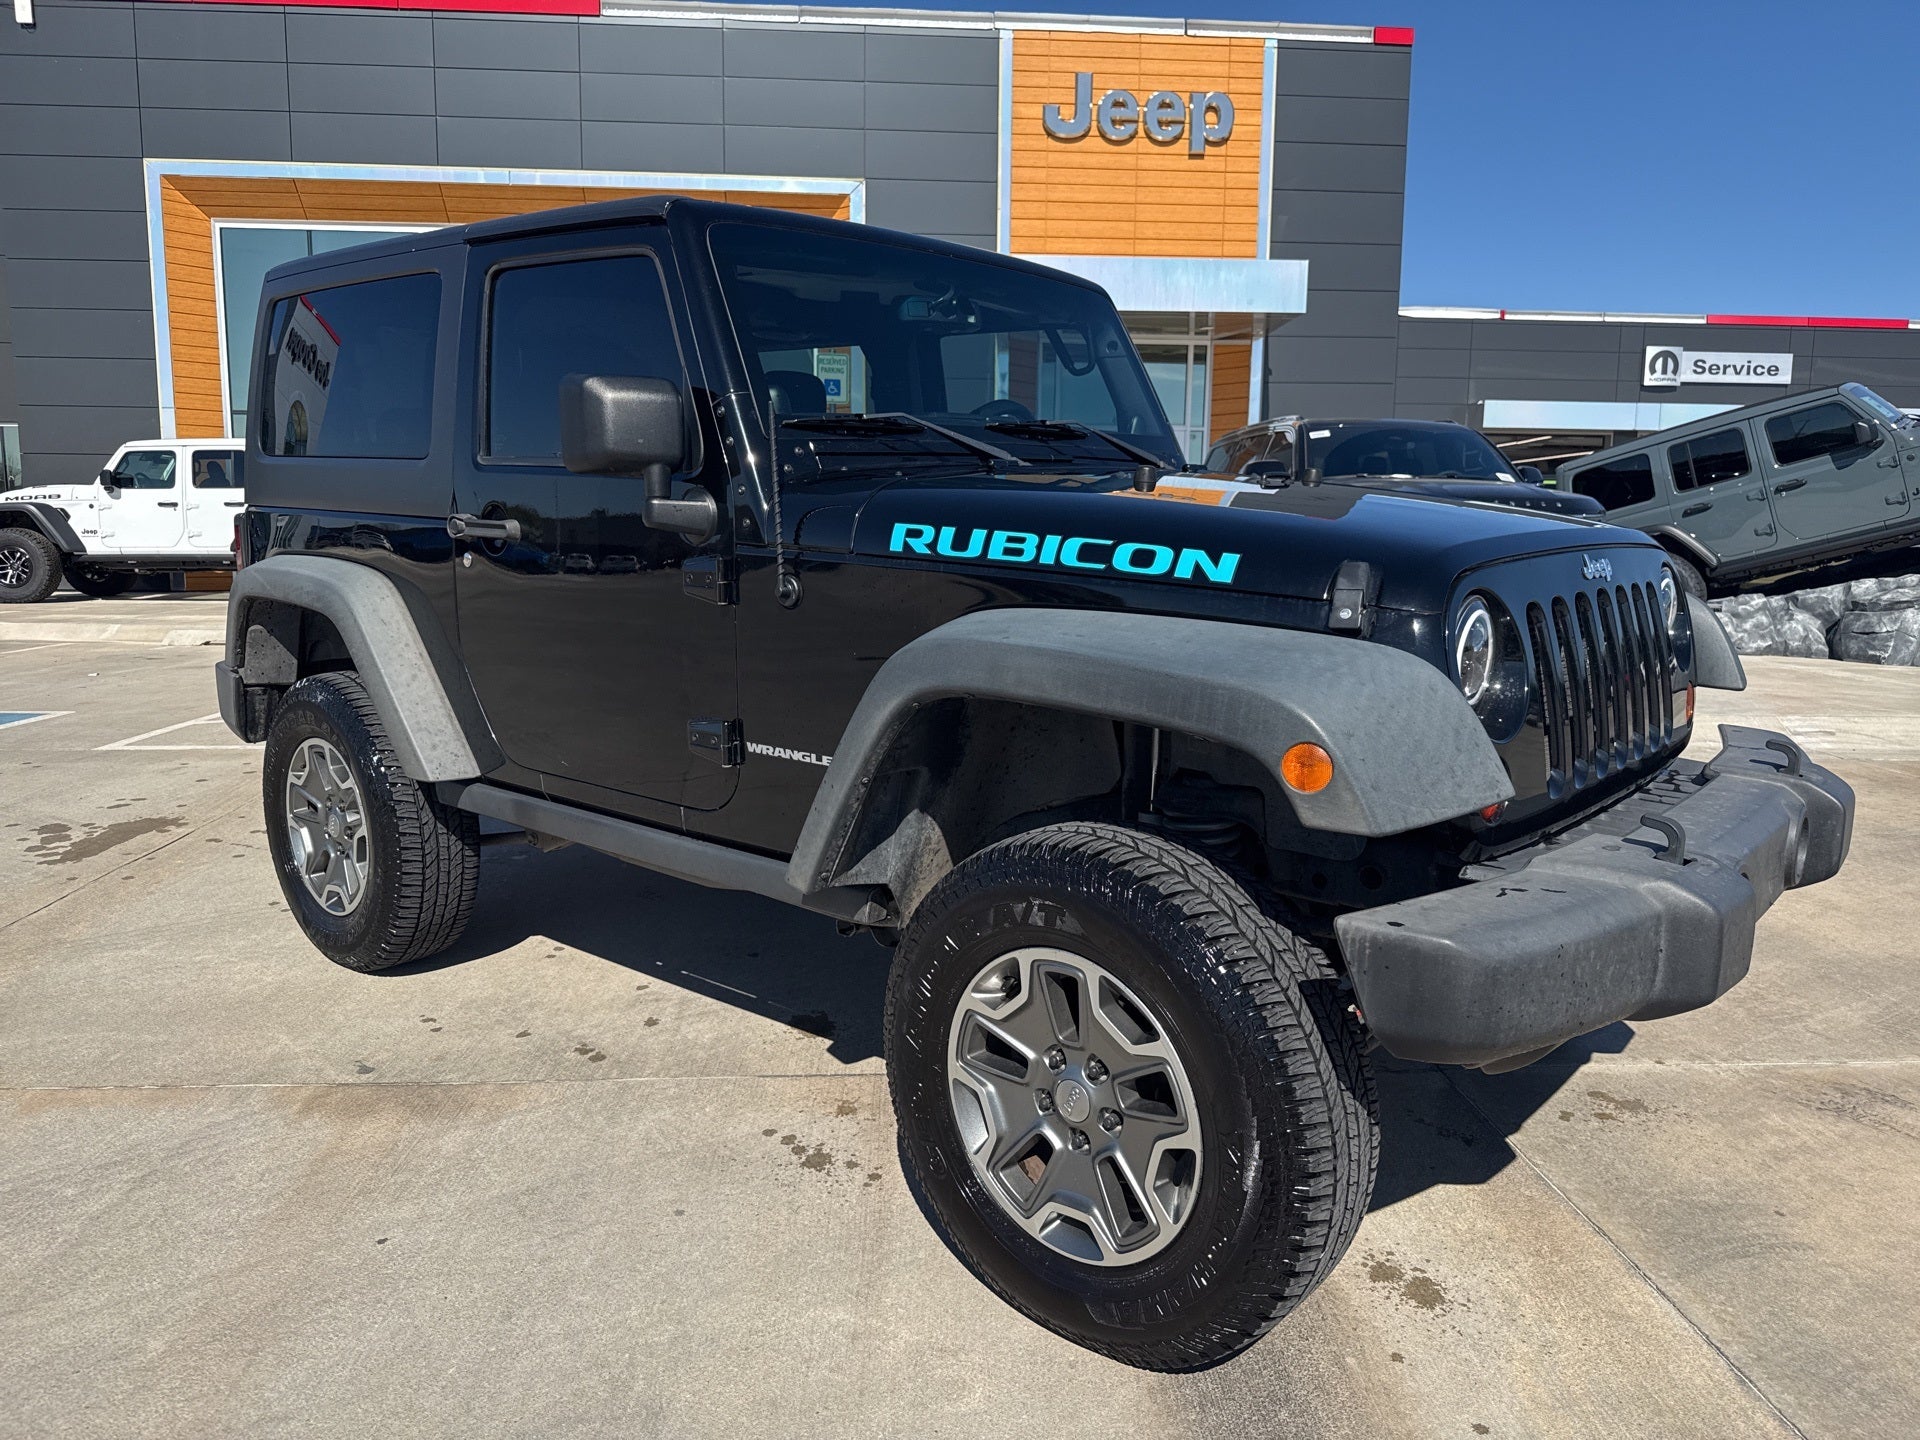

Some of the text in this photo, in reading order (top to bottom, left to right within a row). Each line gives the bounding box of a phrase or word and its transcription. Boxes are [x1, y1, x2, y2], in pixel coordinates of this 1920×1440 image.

[1043, 72, 1234, 154] Jeep
[818, 357, 847, 366] RESERVED
[1692, 359, 1780, 376] Service
[889, 522, 1242, 584] RUBICON
[1582, 553, 1612, 582] Jeep
[746, 741, 833, 767] WRANGLE
[1063, 1087, 1080, 1117] Jeep
